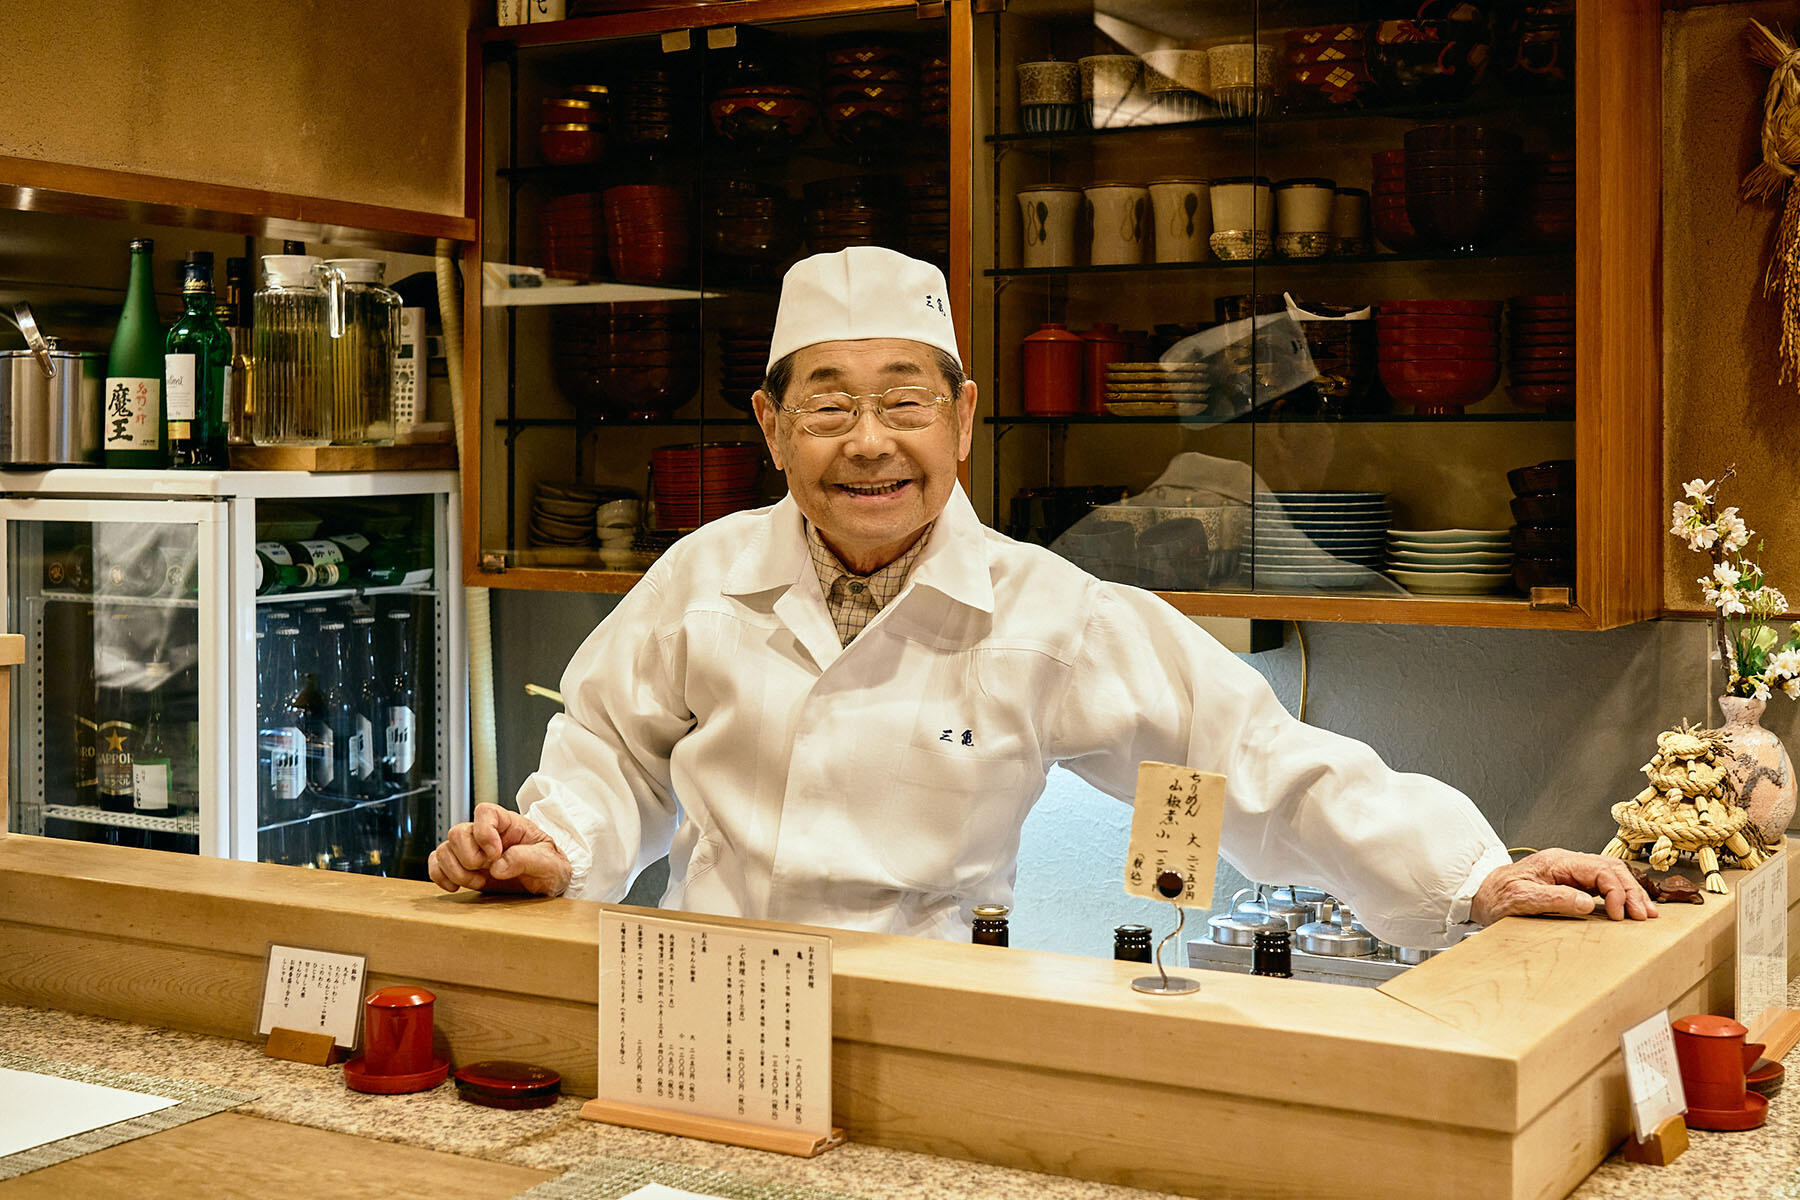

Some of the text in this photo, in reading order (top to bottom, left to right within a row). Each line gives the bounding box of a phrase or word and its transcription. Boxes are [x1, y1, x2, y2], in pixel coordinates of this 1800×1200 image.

[108, 383, 134, 443] 魔王
[939, 729, 975, 747] 三亀
[97, 752, 134, 765] APPOR
[1159, 778, 1183, 826] 山椒煮
[1184, 772, 1202, 817] ちりめん
[1155, 829, 1170, 839] 小
[1186, 833, 1201, 848] 大
